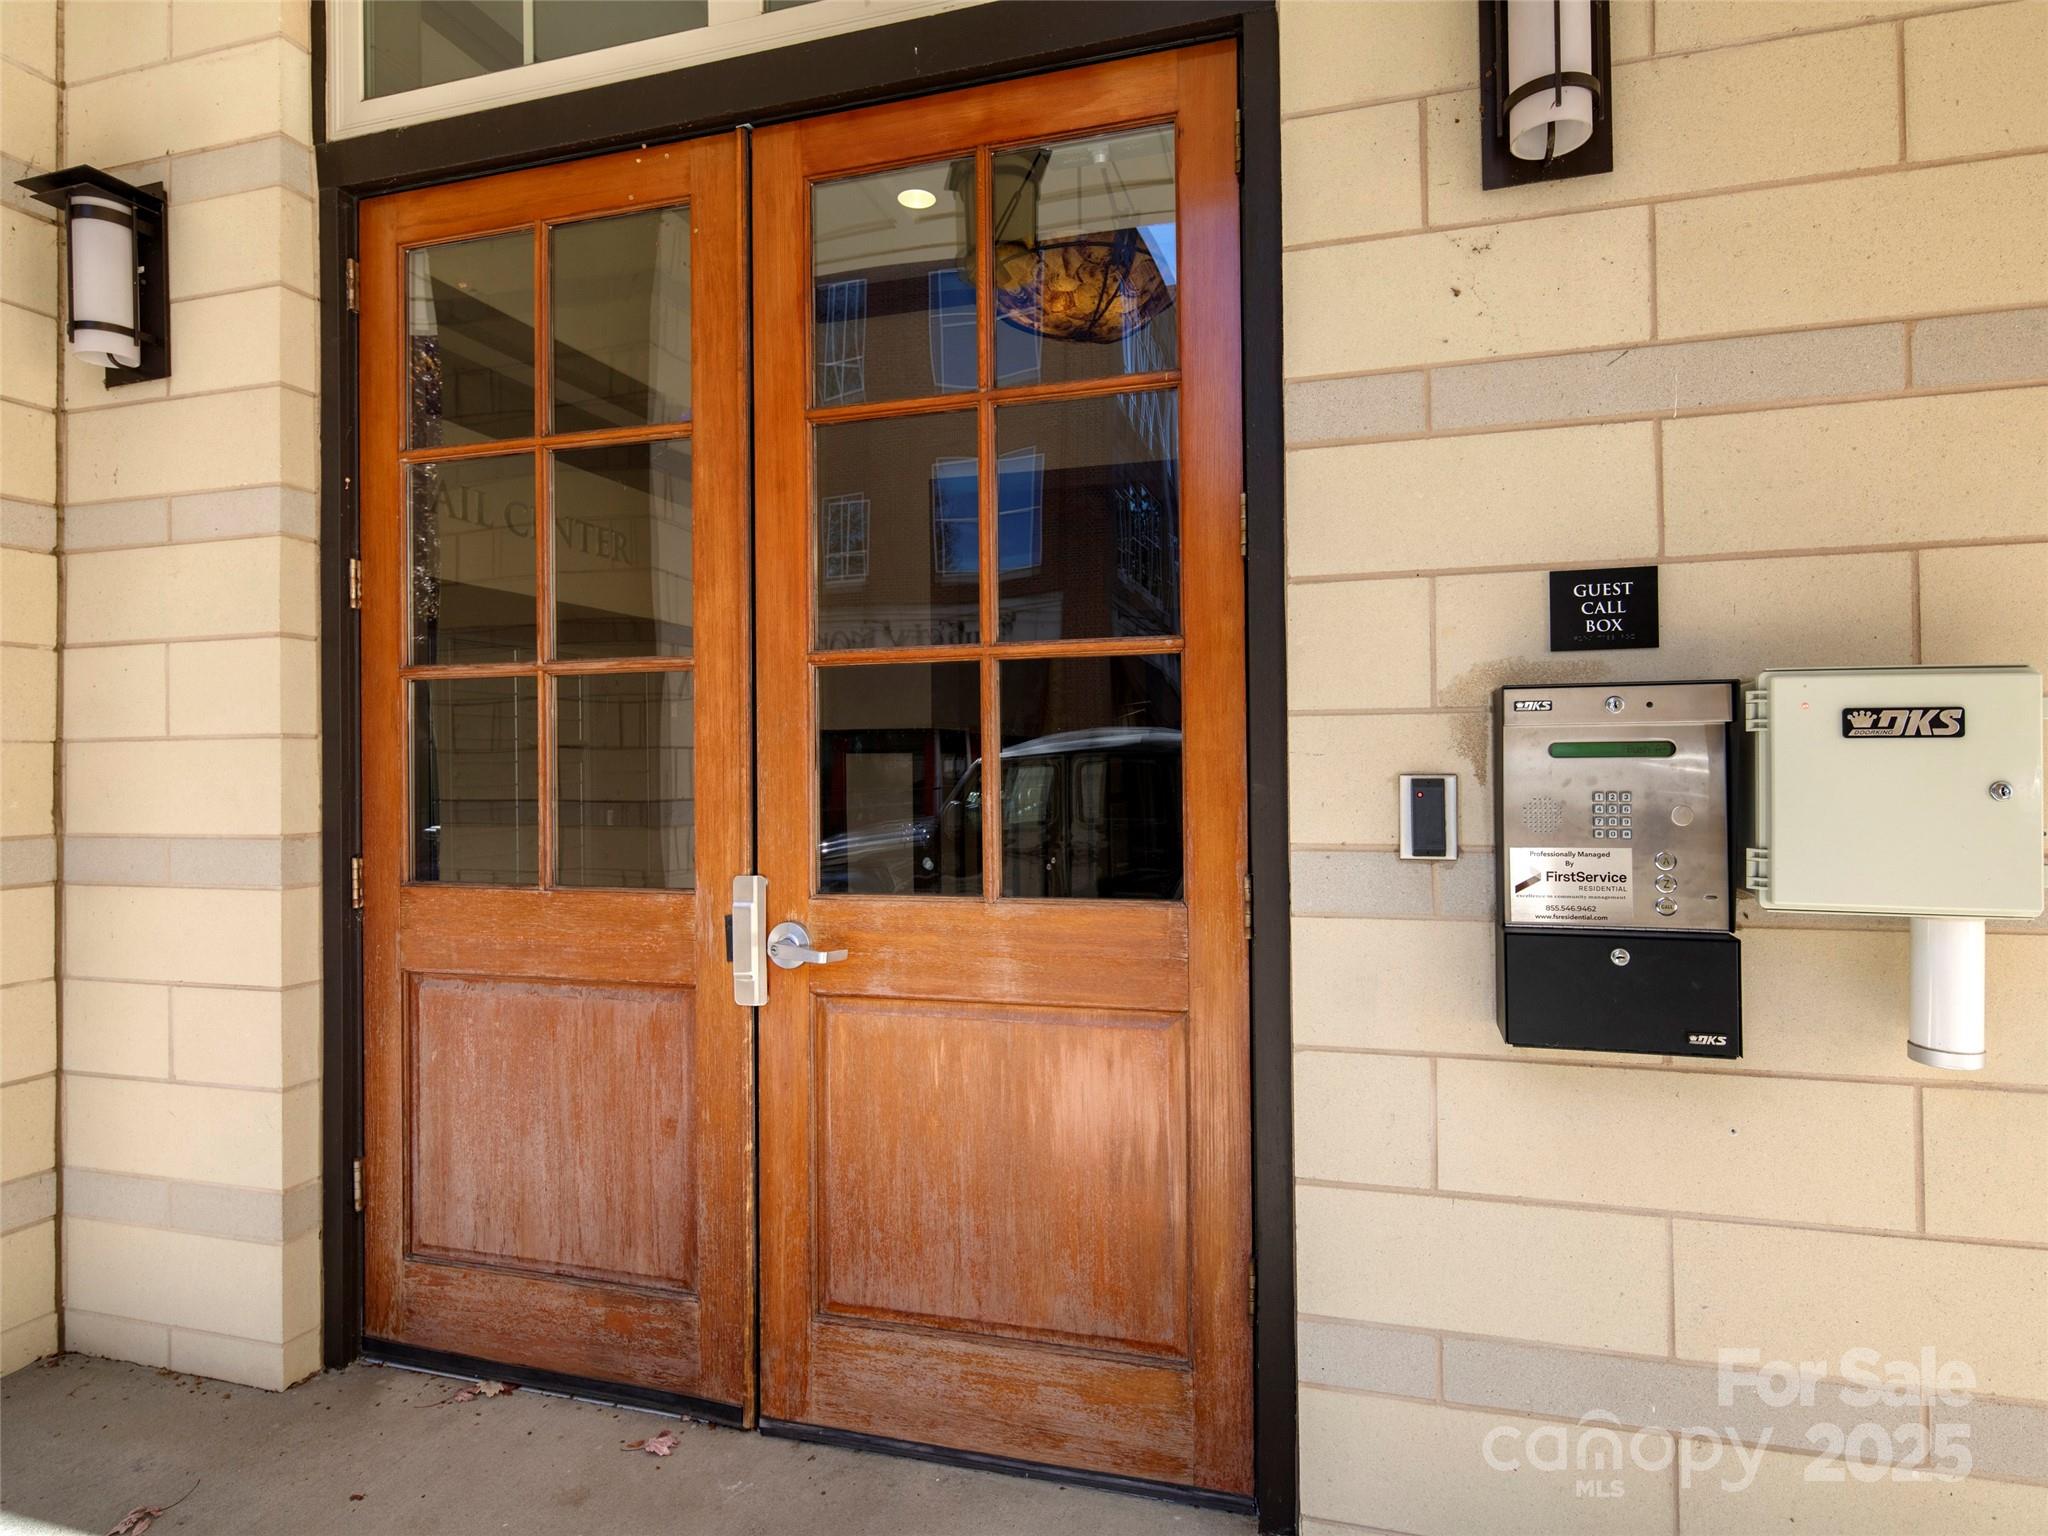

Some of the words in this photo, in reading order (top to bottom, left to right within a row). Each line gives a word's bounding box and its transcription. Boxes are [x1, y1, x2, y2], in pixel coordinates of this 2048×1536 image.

[430, 479, 494, 530] AIL
[504, 501, 633, 567] CNTER
[1573, 581, 1634, 597] GUEST
[1581, 600, 1627, 615] CALL
[1586, 618, 1623, 633] BOX
[1877, 709, 1963, 736] DKS
[1529, 850, 1576, 859] Professionally
[1577, 851, 1611, 859] Managed
[1546, 871, 1627, 883] FirstService
[1663, 879, 1671, 889] Z
[1698, 1035, 1728, 1046] DKS
